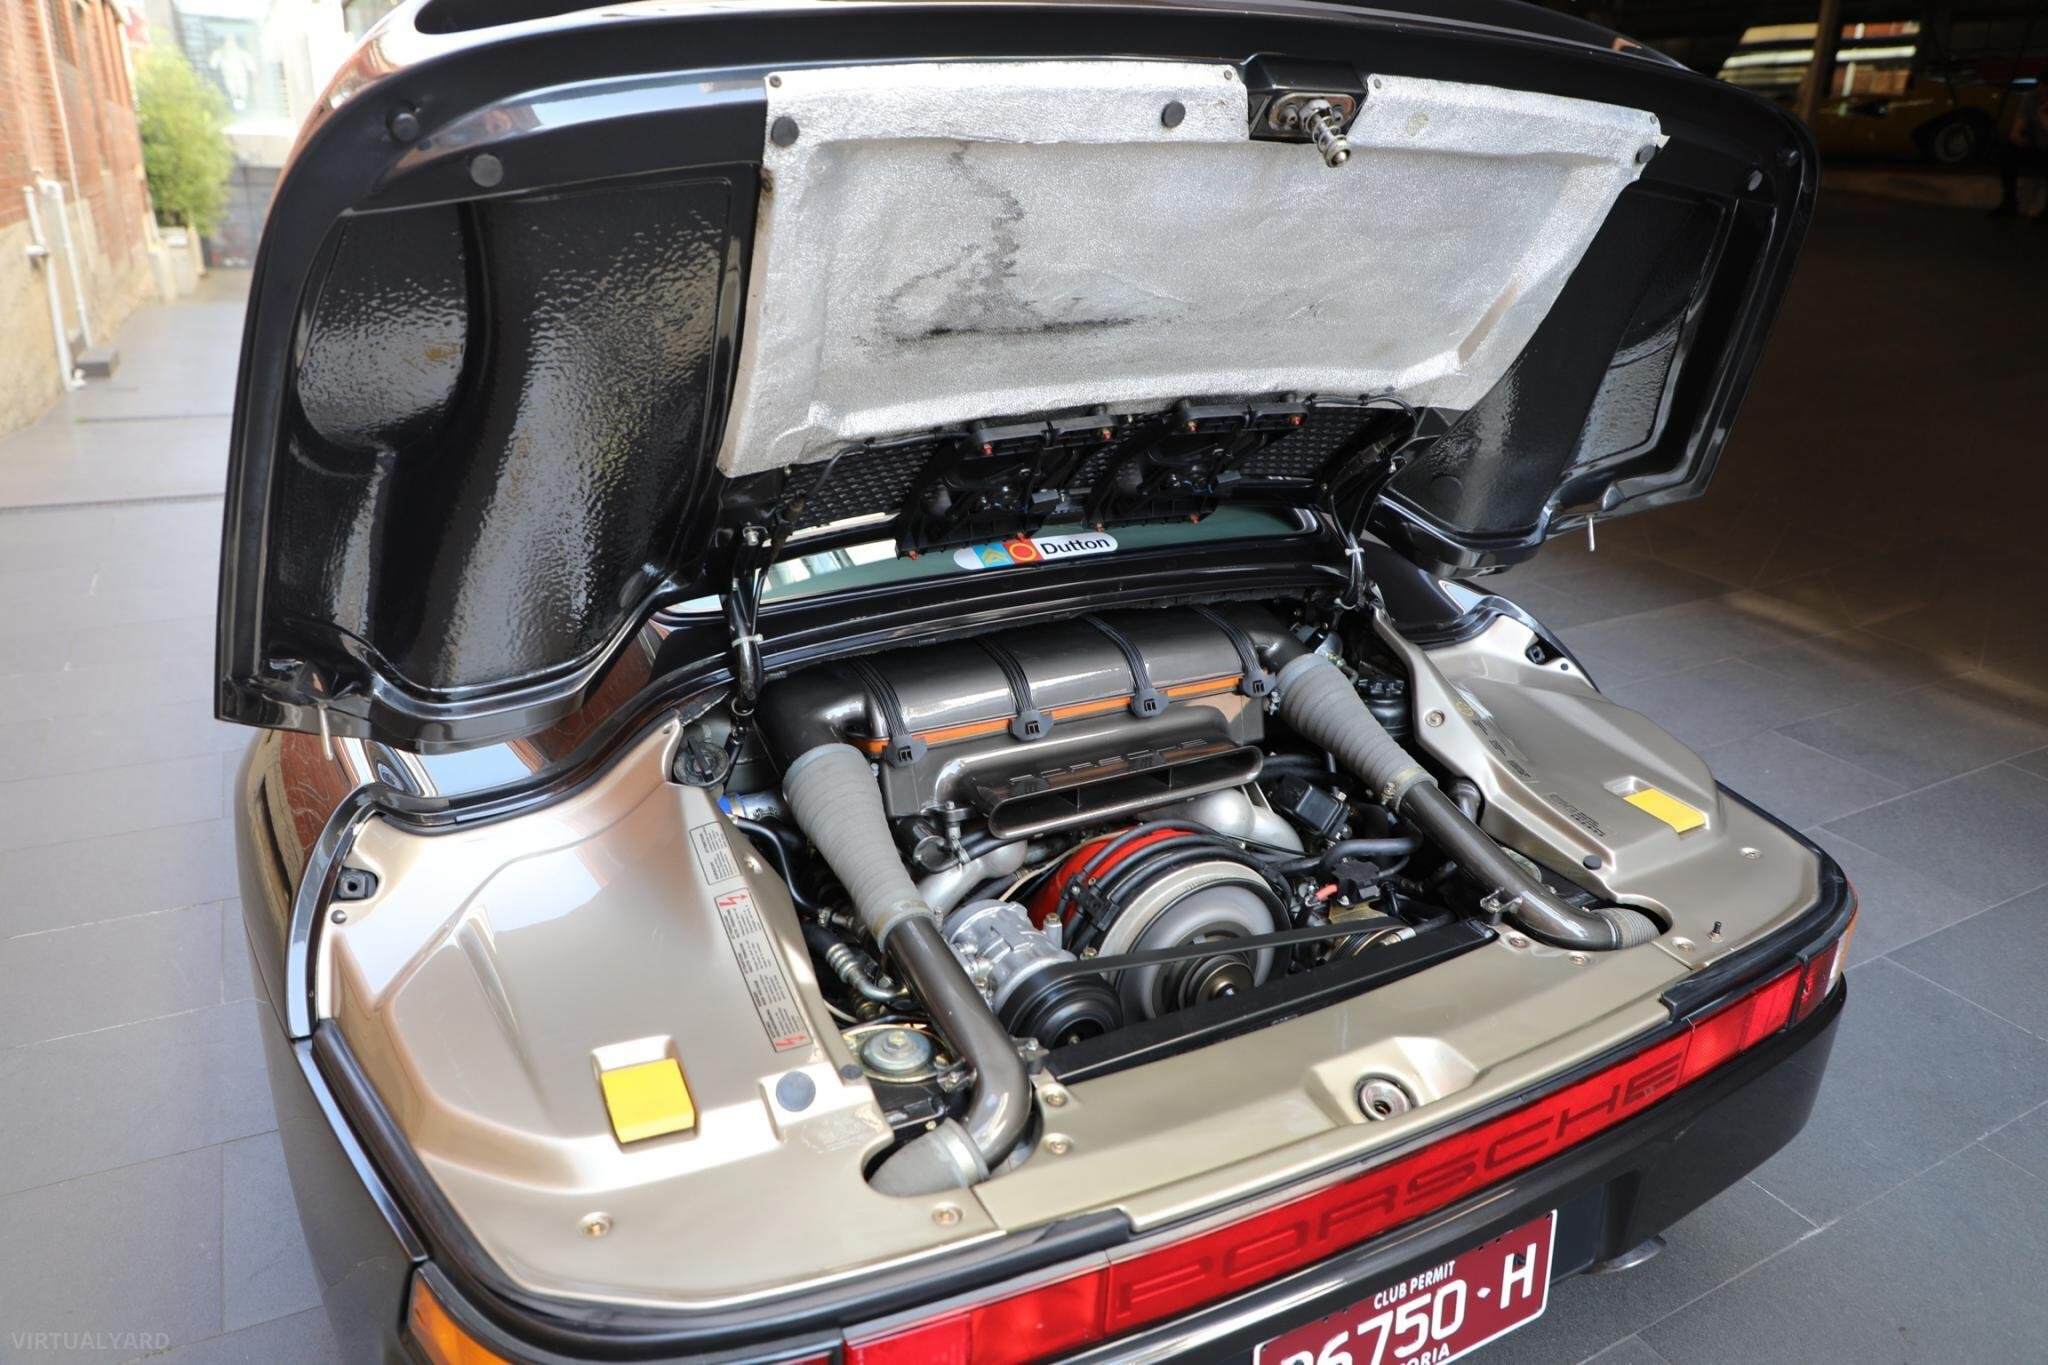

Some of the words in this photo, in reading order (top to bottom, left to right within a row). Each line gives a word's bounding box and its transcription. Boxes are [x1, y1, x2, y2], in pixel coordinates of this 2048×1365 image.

[1041, 537, 1110, 555] Dutton
[1117, 1051, 1683, 1319] PORSCHE
[1373, 1281, 1407, 1310] CLUB
[1410, 1260, 1456, 1294] PERMIT
